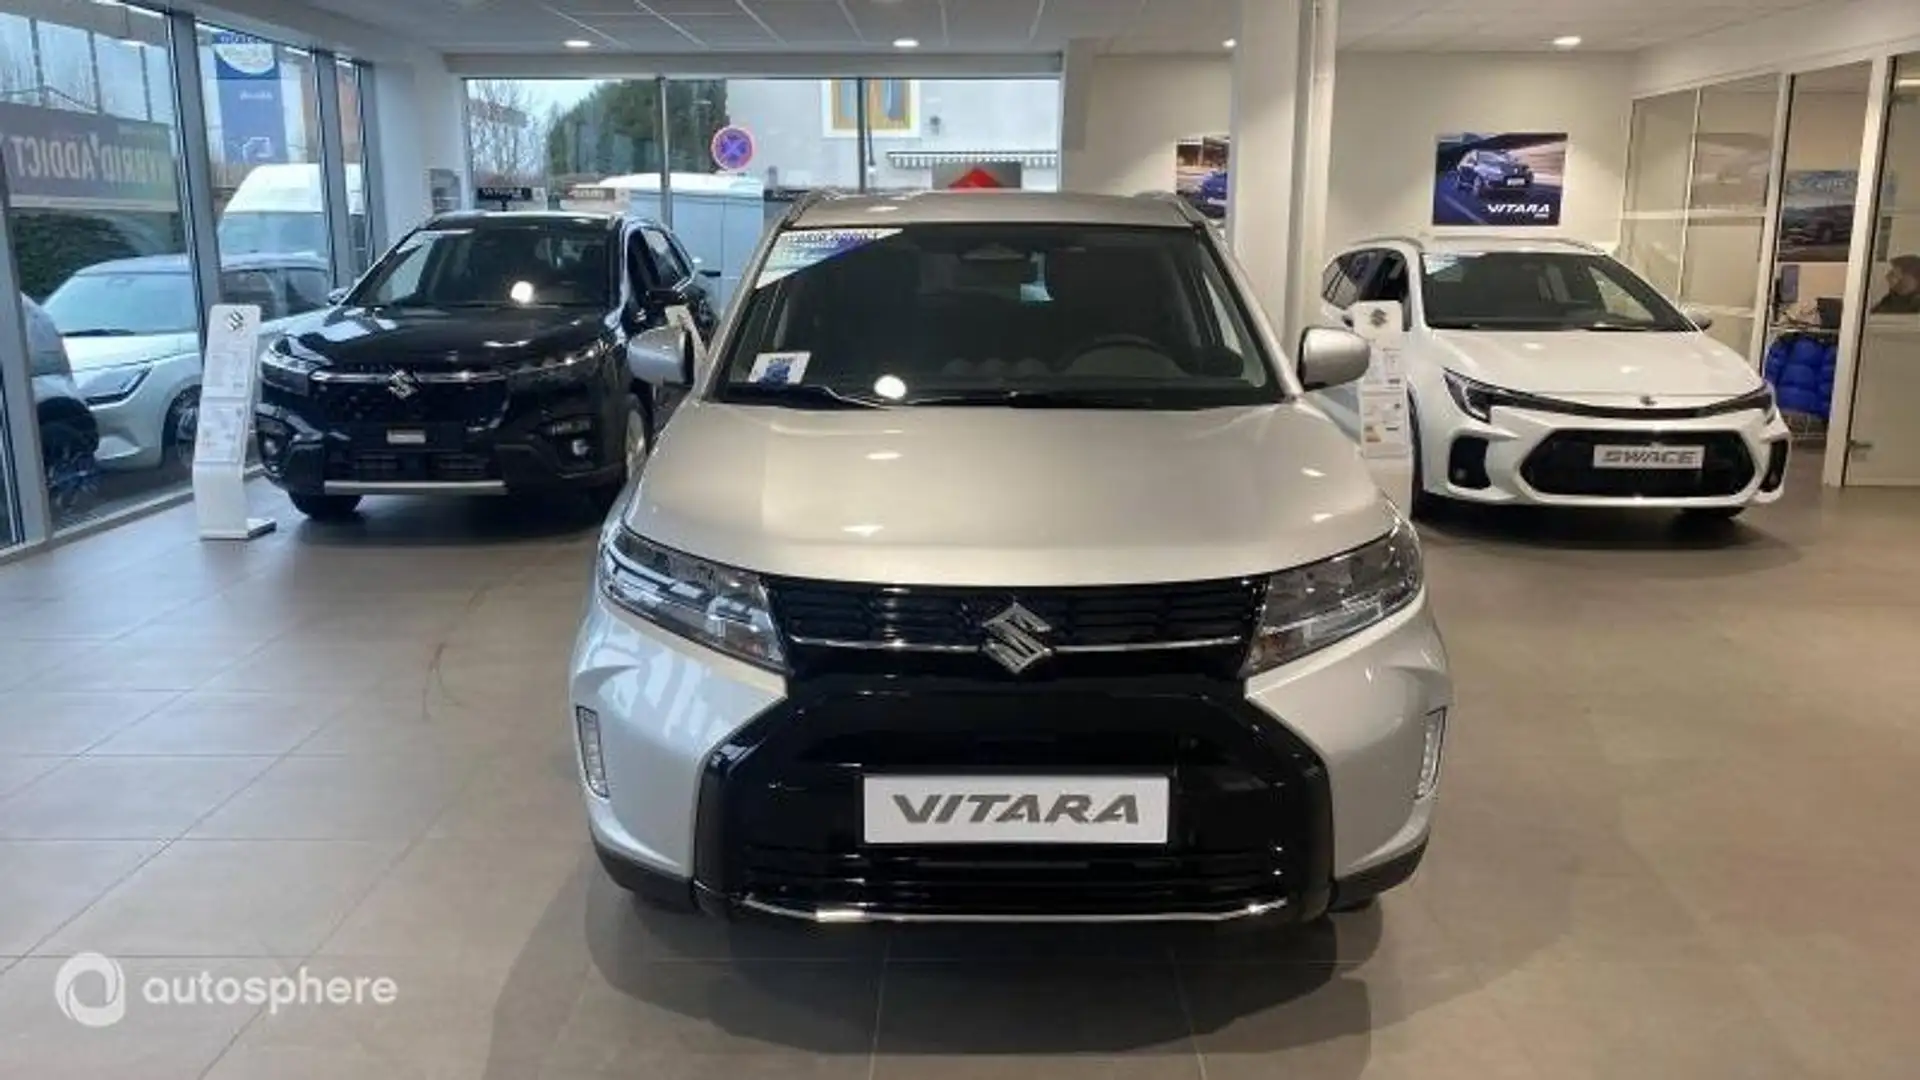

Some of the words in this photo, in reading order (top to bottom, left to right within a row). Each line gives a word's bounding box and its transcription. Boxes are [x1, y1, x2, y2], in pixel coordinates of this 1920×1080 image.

[1486, 203, 1550, 213] VITARA
[1602, 450, 1698, 464] SWACE
[892, 793, 1139, 824] VITARA
